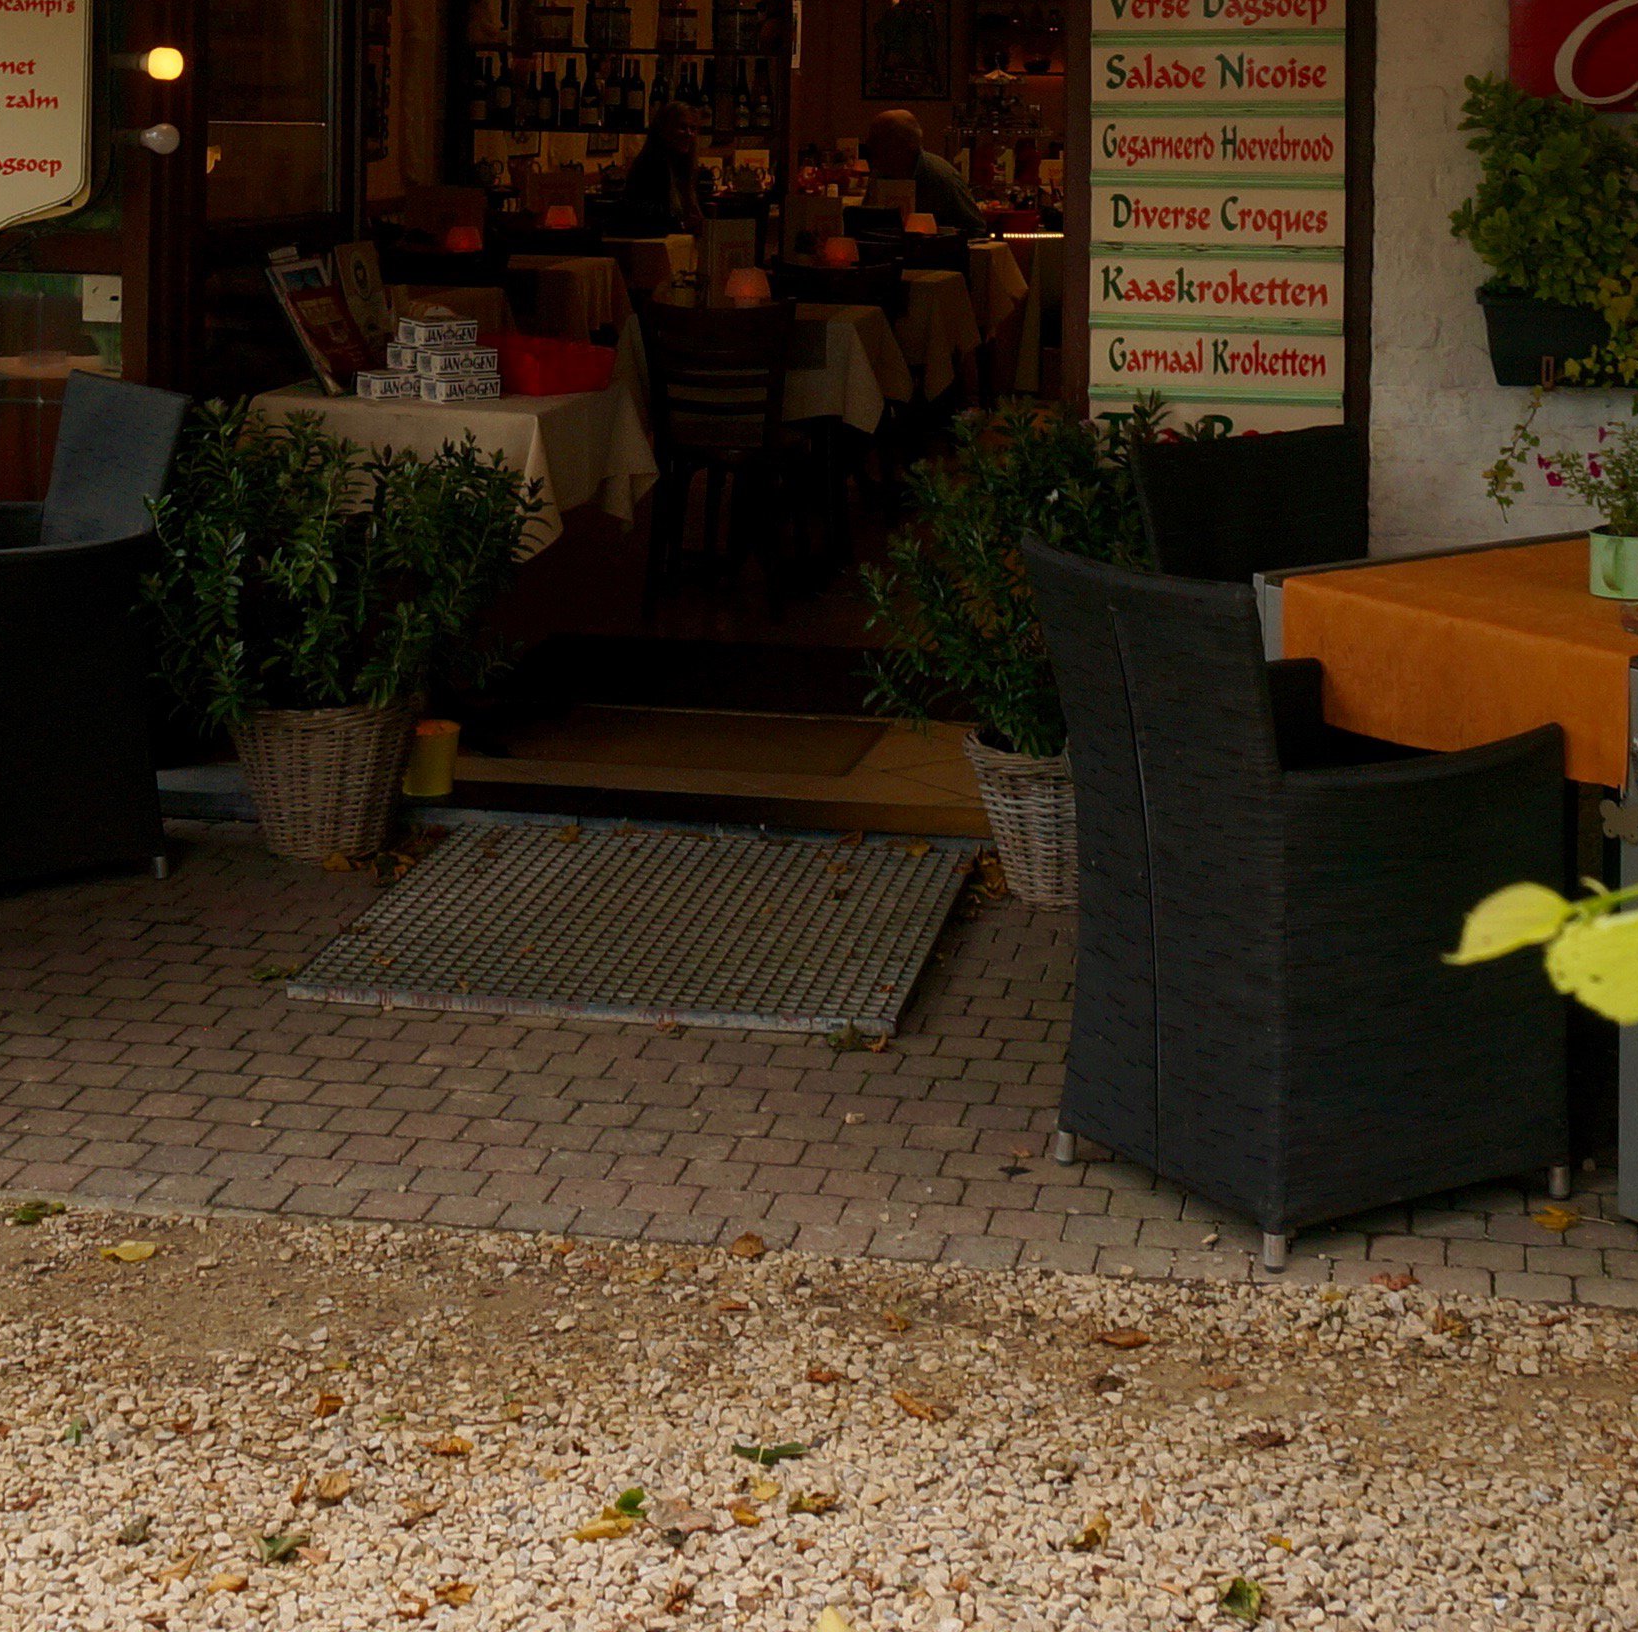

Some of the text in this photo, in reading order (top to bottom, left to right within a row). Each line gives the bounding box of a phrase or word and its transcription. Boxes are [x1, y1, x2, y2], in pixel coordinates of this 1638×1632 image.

[1106, 52, 1327, 89] Salade Nicoise
[5, 88, 59, 110] zalm
[1102, 124, 1334, 167] Gegarneerd Hoevebrood
[1110, 193, 1328, 240] Diverse Croques
[1101, 265, 1328, 307] Kaaskroketten
[1109, 337, 1326, 377] Garnaal Kroketten
